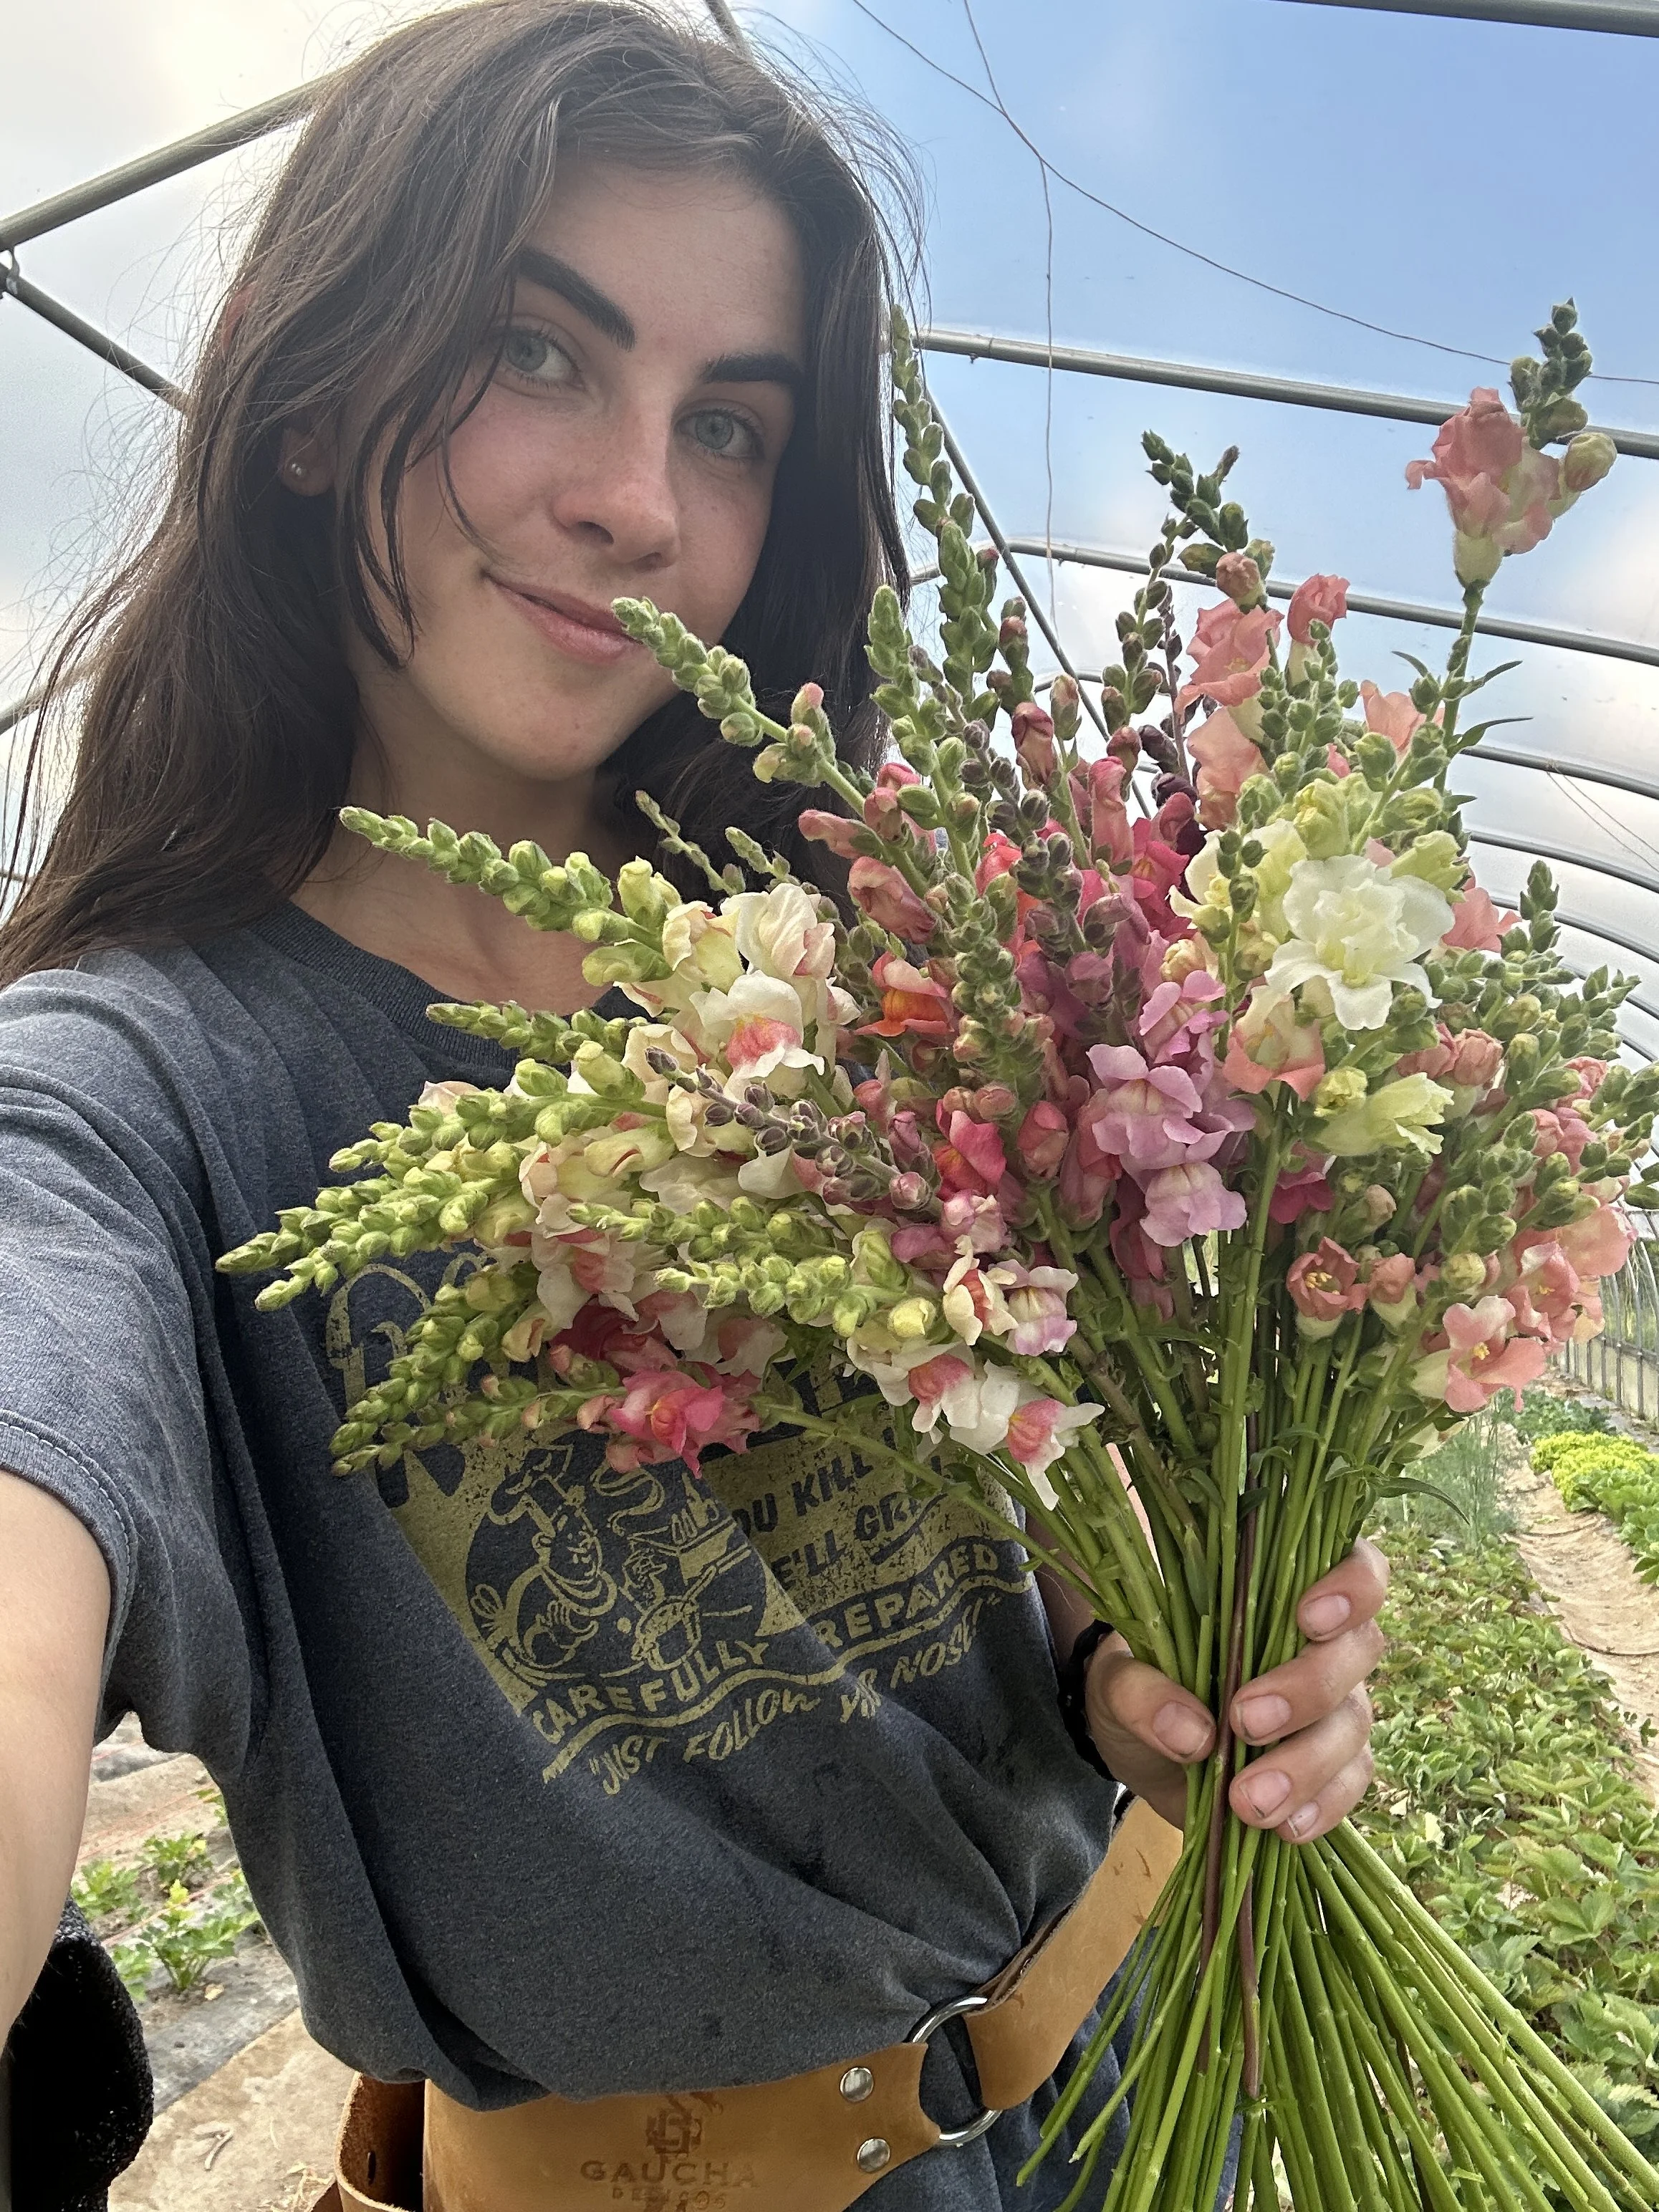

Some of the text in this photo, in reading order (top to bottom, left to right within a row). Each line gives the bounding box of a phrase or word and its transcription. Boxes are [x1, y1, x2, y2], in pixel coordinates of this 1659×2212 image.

[732, 1492, 779, 1539] OU
[791, 1451, 873, 1517] KILL
[533, 1544, 1000, 1744] CAREFULLY REPARED
[580, 2160, 760, 2188] GAUCHA
